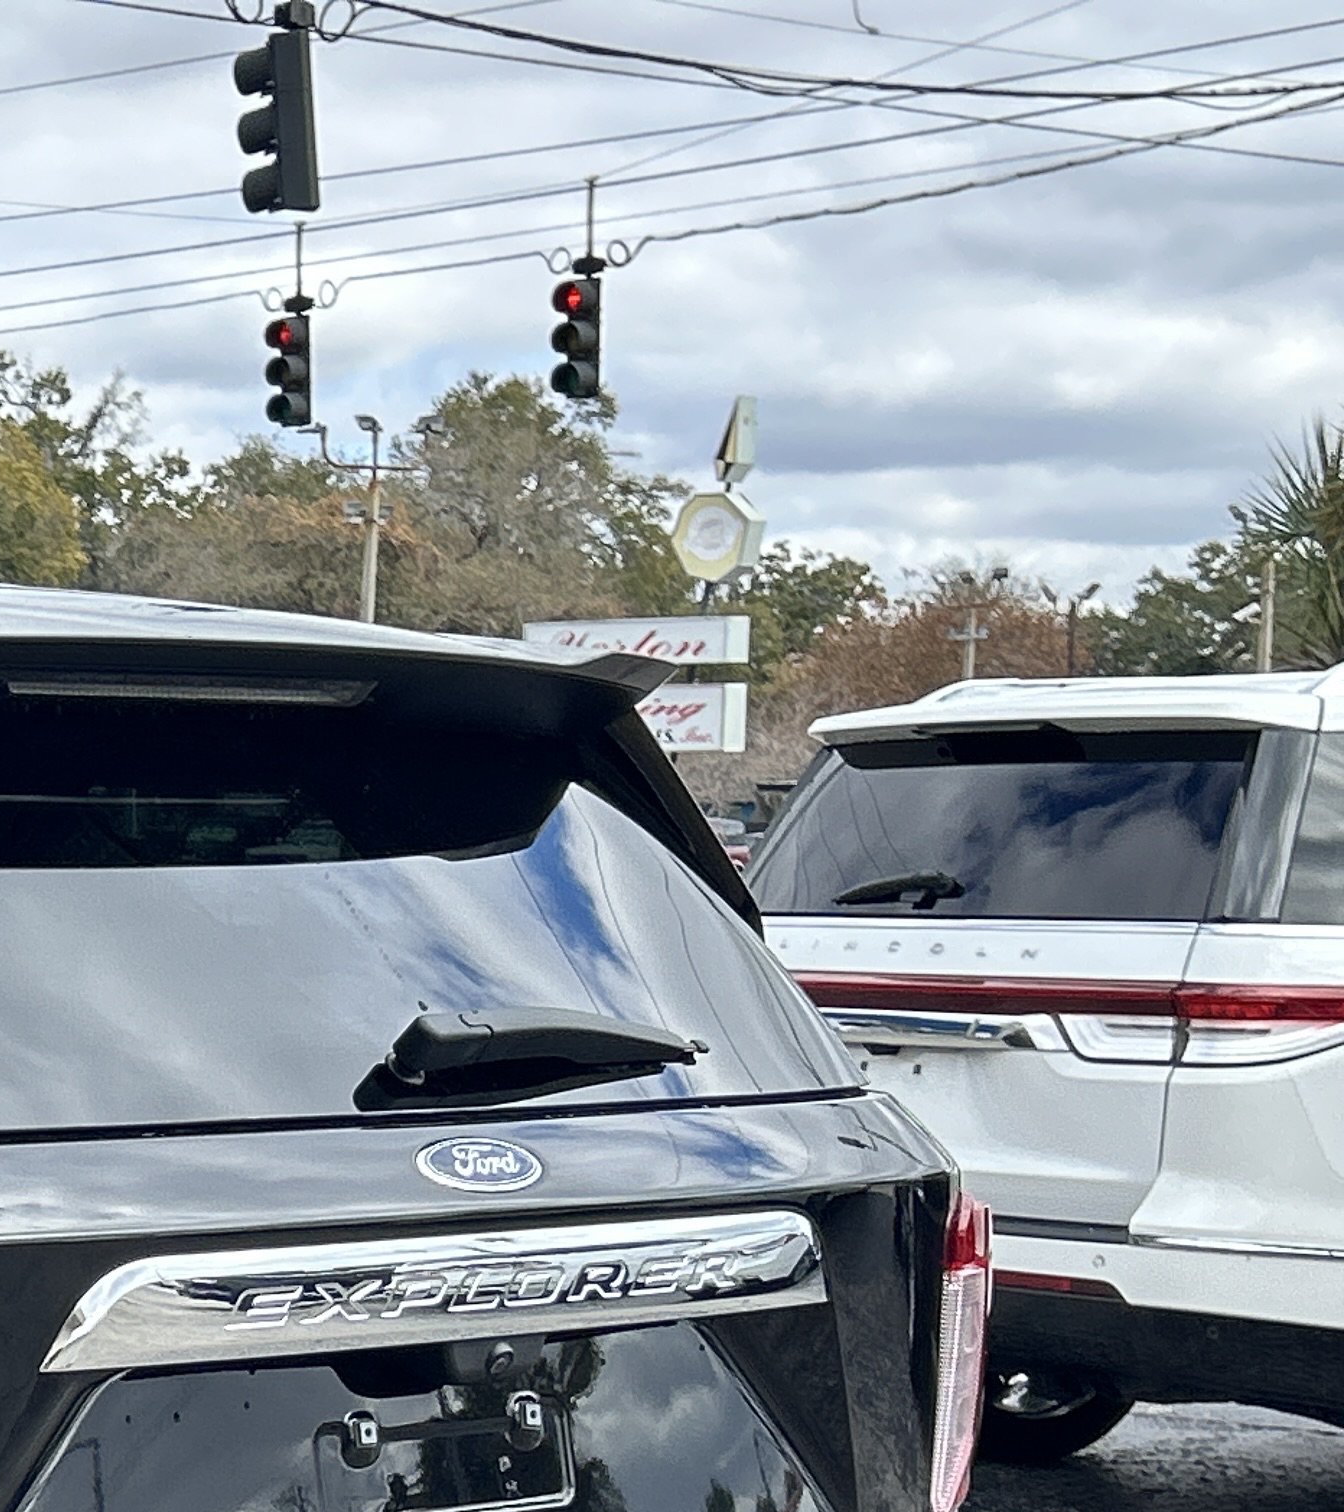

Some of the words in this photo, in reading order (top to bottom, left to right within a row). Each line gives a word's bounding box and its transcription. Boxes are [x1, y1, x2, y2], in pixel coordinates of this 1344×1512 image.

[778, 939, 1040, 960] LINCOLN
[452, 1145, 520, 1177] Ford
[224, 1249, 742, 1331] EXPLORER
